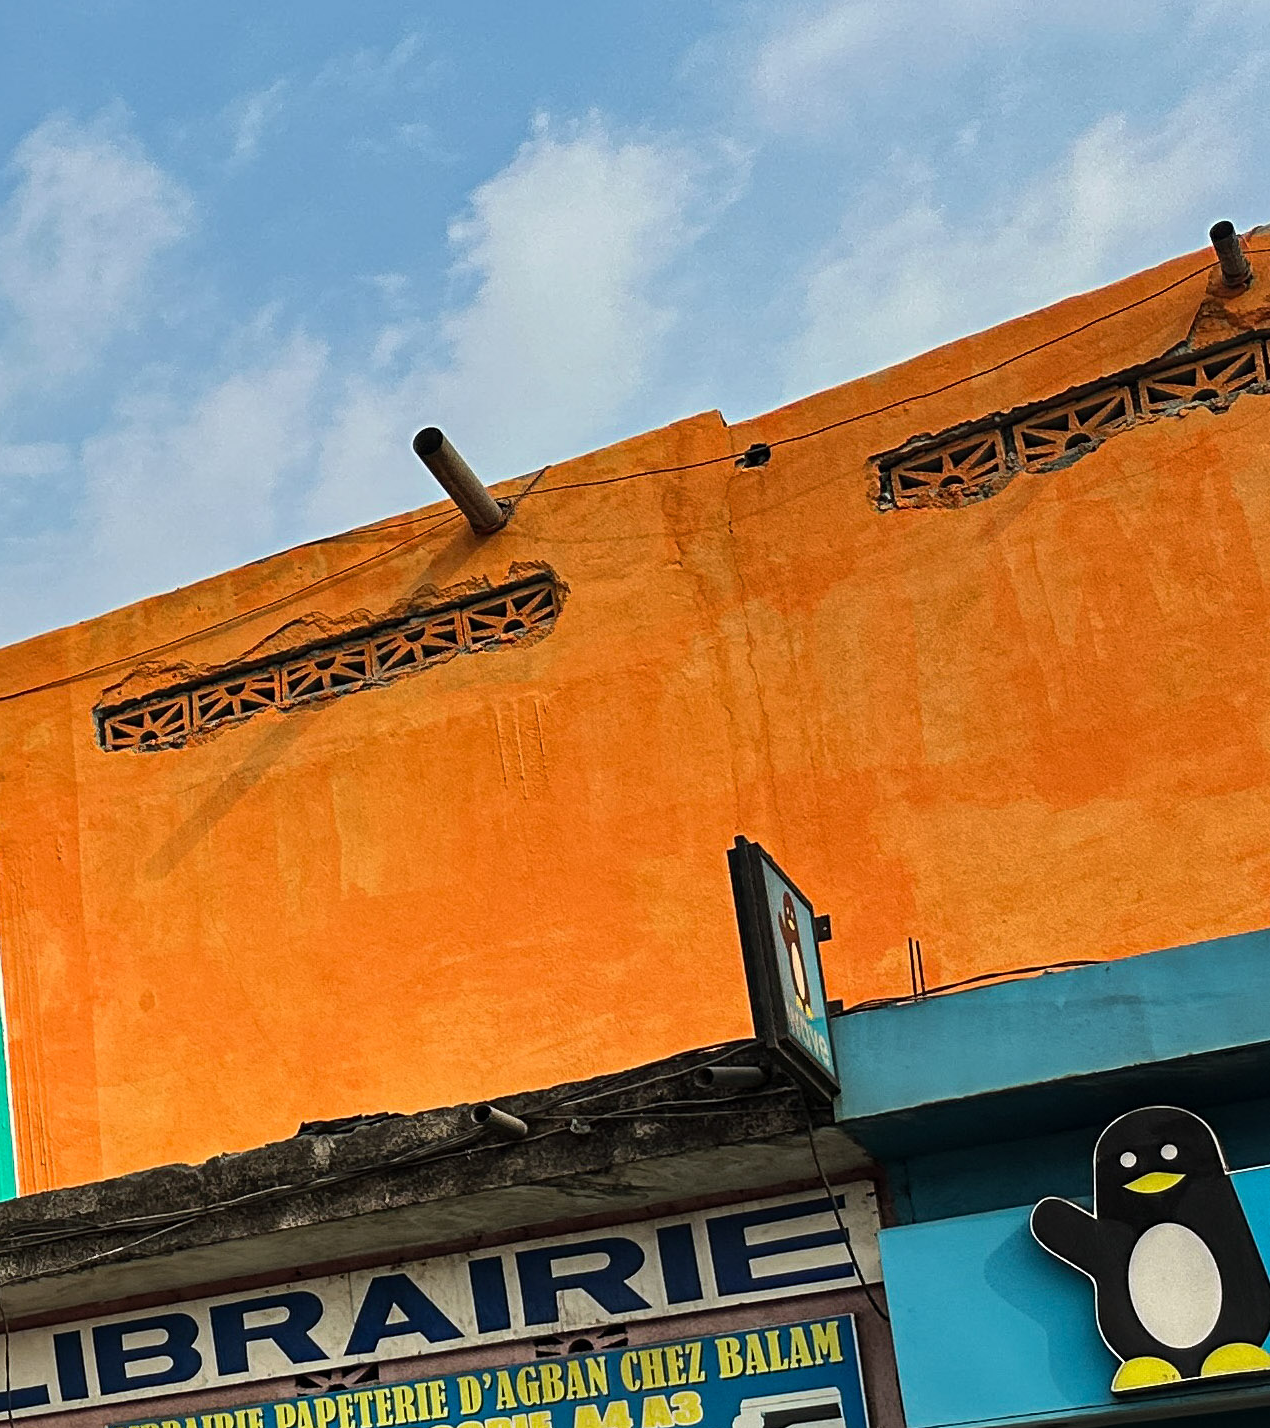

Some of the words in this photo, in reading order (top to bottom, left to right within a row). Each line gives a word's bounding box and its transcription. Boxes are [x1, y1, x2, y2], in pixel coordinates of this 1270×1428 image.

[458, 1356, 609, 1411] D'AGBAN
[620, 1342, 705, 1390] CHEZ
[715, 1321, 844, 1379] BALAM
